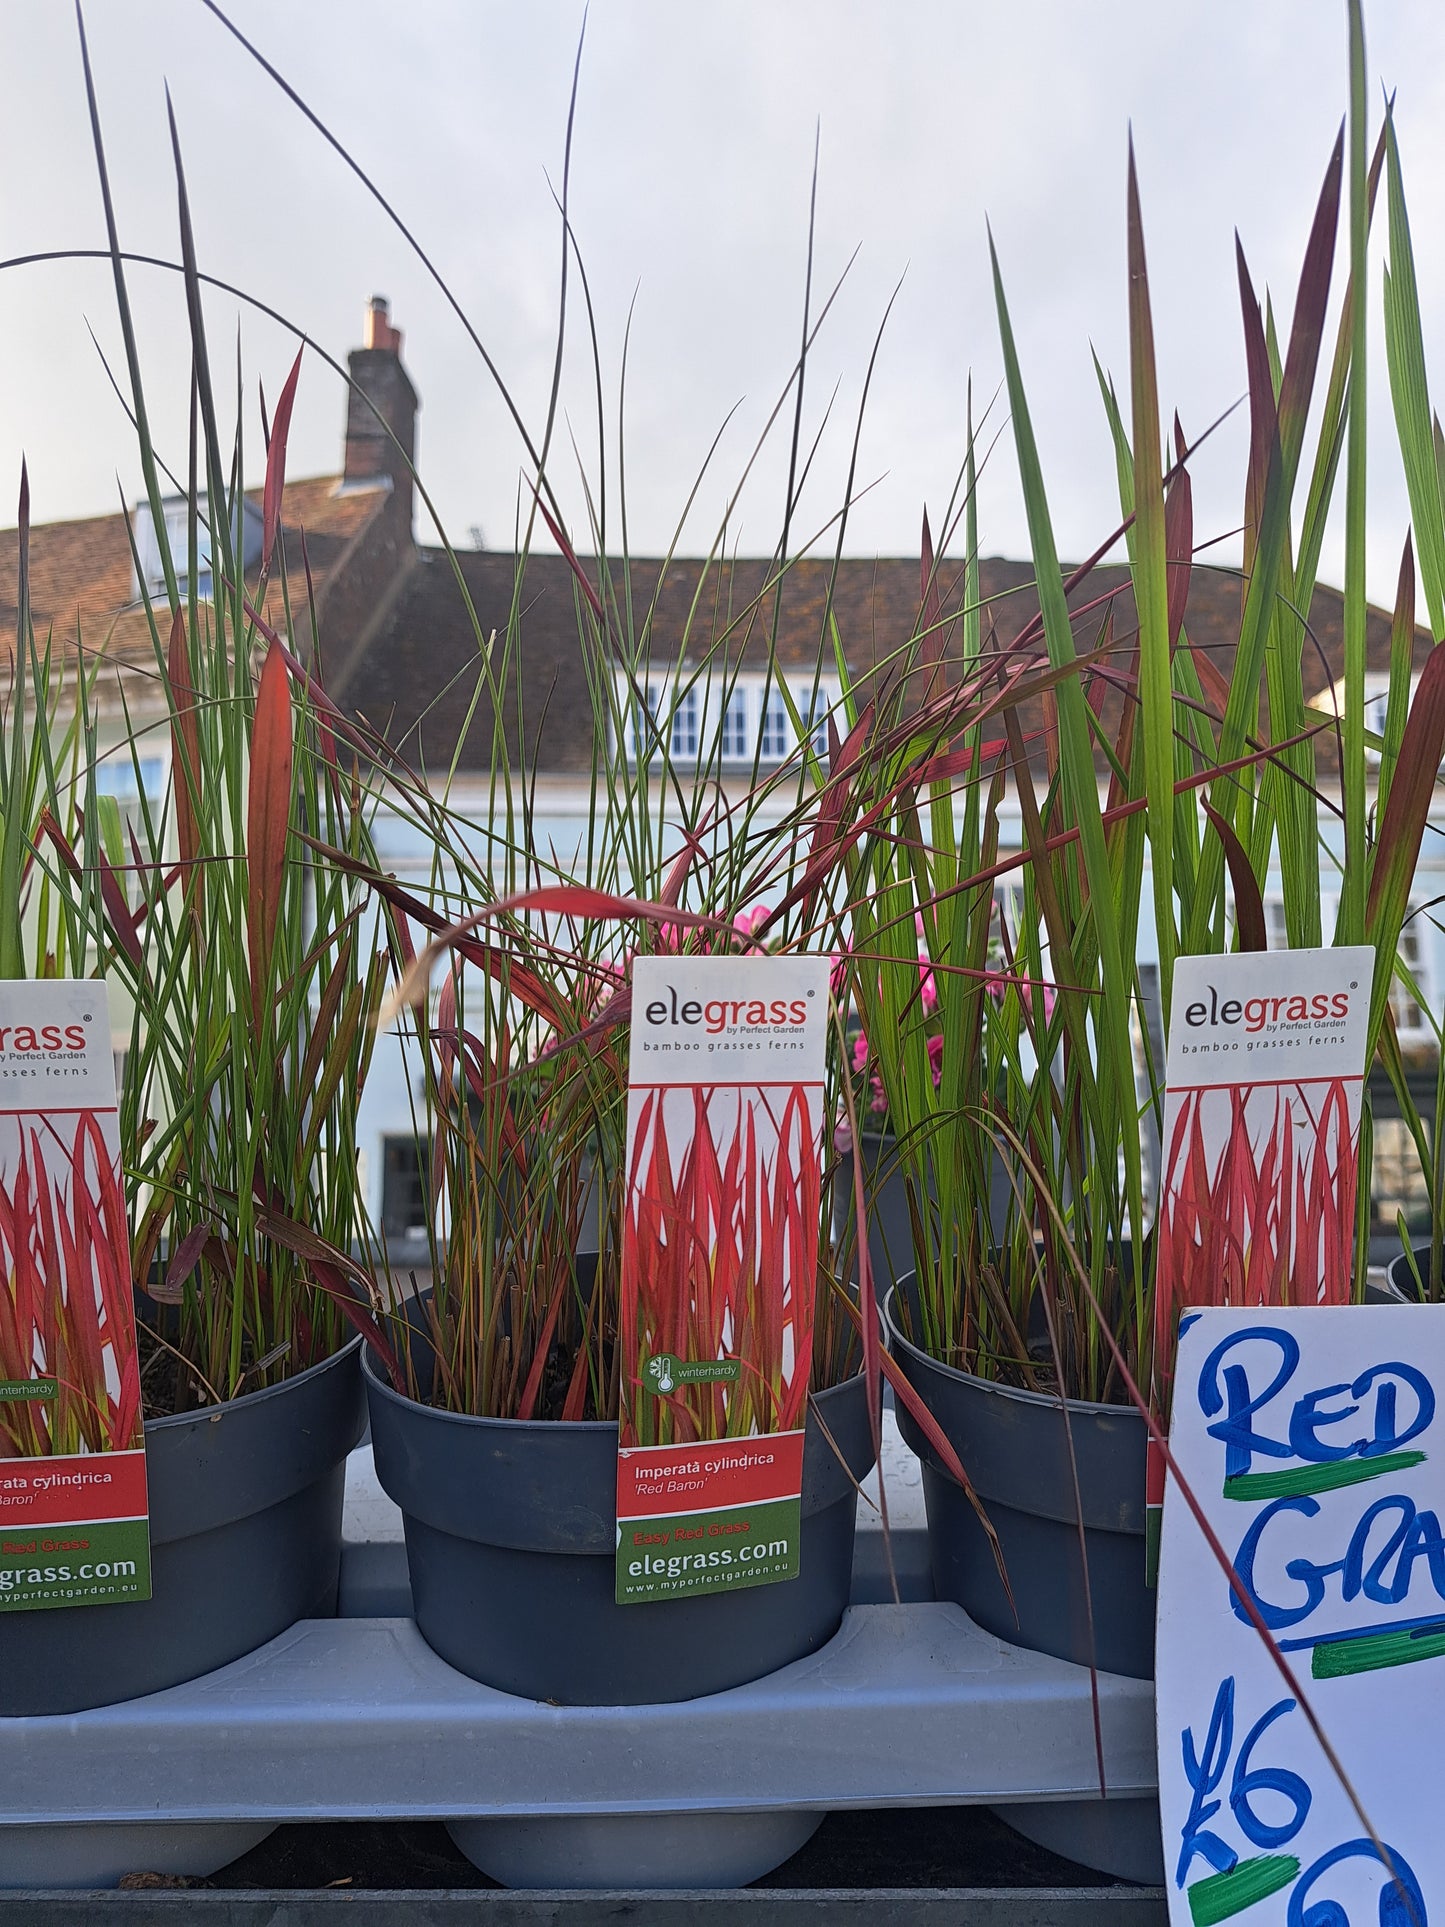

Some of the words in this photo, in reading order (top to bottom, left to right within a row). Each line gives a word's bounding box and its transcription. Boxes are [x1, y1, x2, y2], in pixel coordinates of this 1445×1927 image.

[726, 1026, 738, 1036] by
[739, 1025, 771, 1034] Perfect
[773, 1025, 805, 1034] Garden
[1266, 1023, 1278, 1033] by
[1279, 1021, 1312, 1031] Perfect
[1313, 1019, 1347, 1029] Garden
[643, 1041, 700, 1051] bamboo
[708, 1041, 761, 1052] grasses
[768, 1040, 805, 1050] ferns
[1182, 1042, 1239, 1054] bamboo
[1246, 1038, 1301, 1052] grasses
[1308, 1035, 1346, 1046] ferns
[9, 1052, 46, 1061] Perfect
[48, 1051, 86, 1060] Garden
[46, 1066, 88, 1076] ferns
[678, 1365, 737, 1378] winterhardy
[1198, 1326, 1435, 1479] RED
[704, 1453, 775, 1473] cylindrica
[33, 1472, 112, 1490] cylindrica
[635, 1482, 664, 1496] 'Red
[666, 1478, 709, 1493] Baron'
[633, 1531, 670, 1546] Easy
[674, 1526, 704, 1541] Red
[707, 1521, 751, 1537] Grass
[2, 1540, 37, 1555] Red
[41, 1538, 90, 1552] Grass
[628, 1539, 788, 1578] elegrass.com
[625, 1562, 789, 1593] www.myperfectgarden.eu
